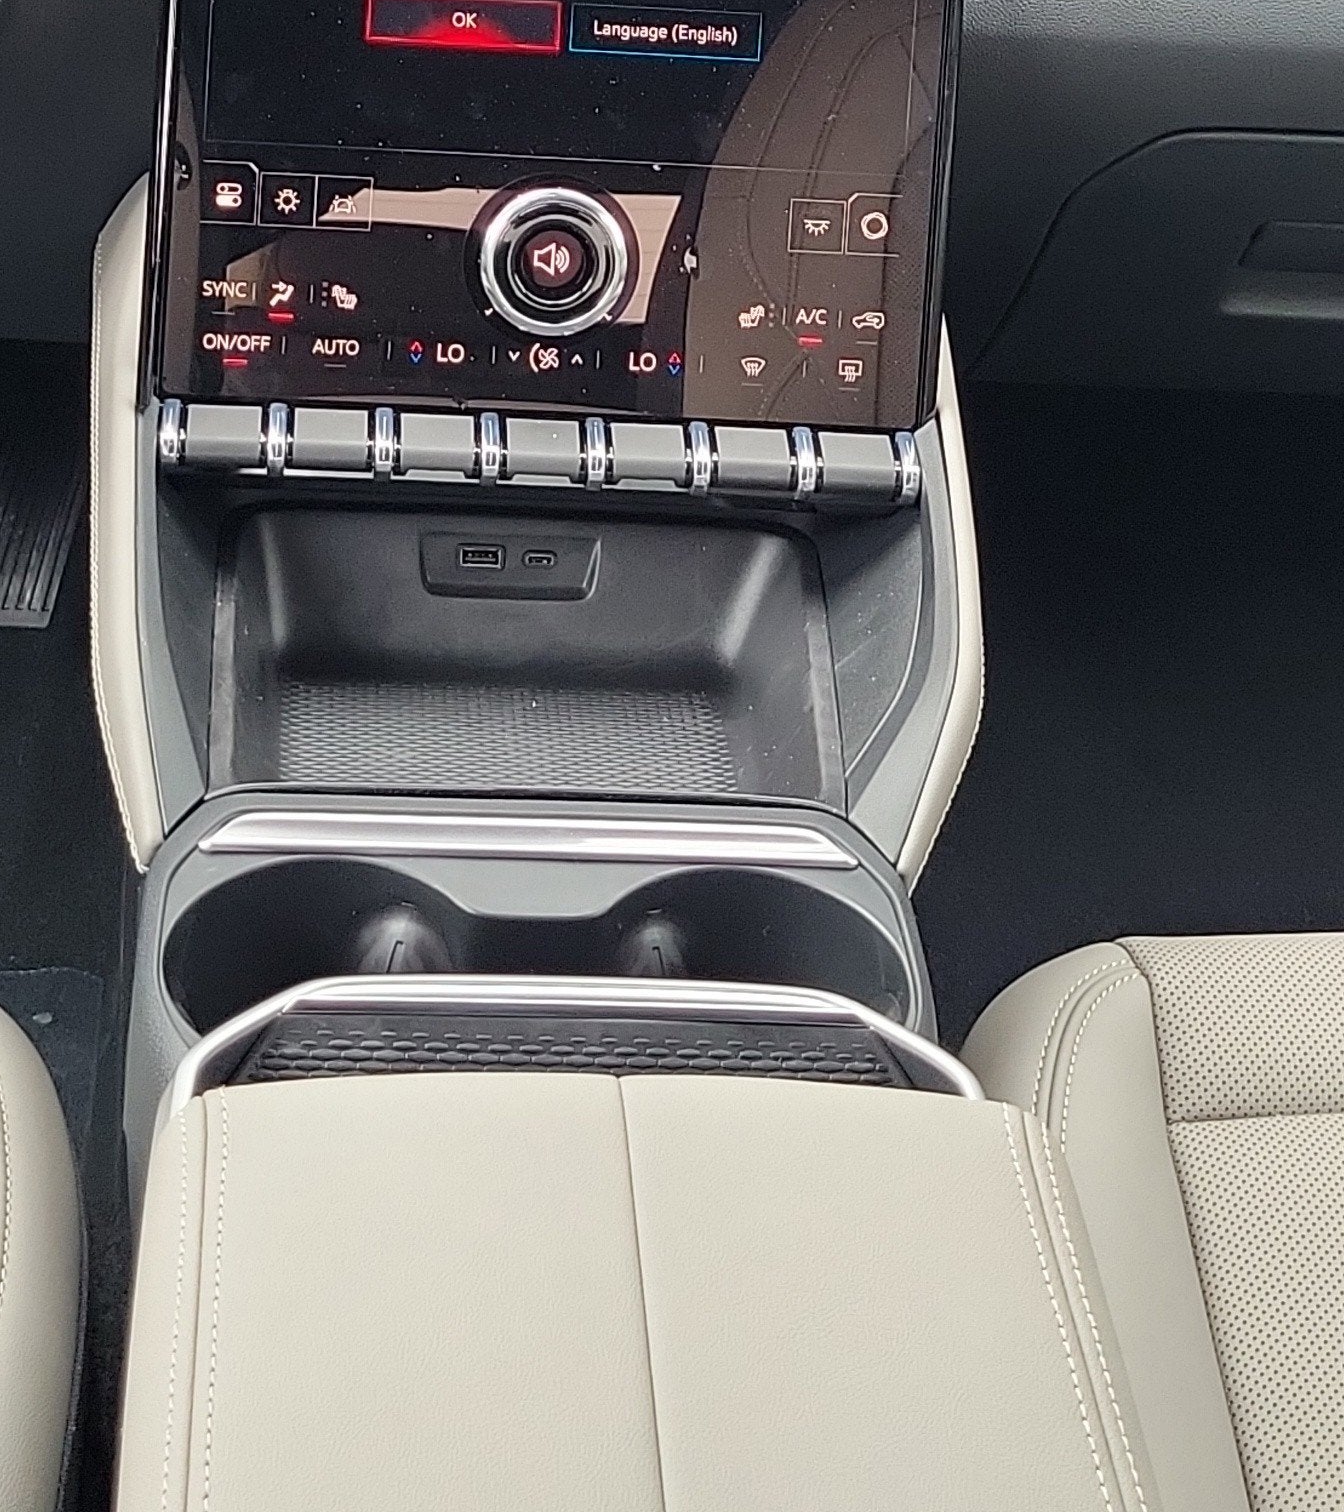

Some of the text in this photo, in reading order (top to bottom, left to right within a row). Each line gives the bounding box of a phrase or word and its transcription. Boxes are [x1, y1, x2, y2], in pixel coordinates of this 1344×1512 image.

[452, 11, 738, 46] OK Language (English)
[202, 280, 248, 298] SYNC
[796, 308, 828, 325] A/C
[202, 333, 465, 363] ON/OFF AUTO LO
[629, 352, 656, 372] LO
